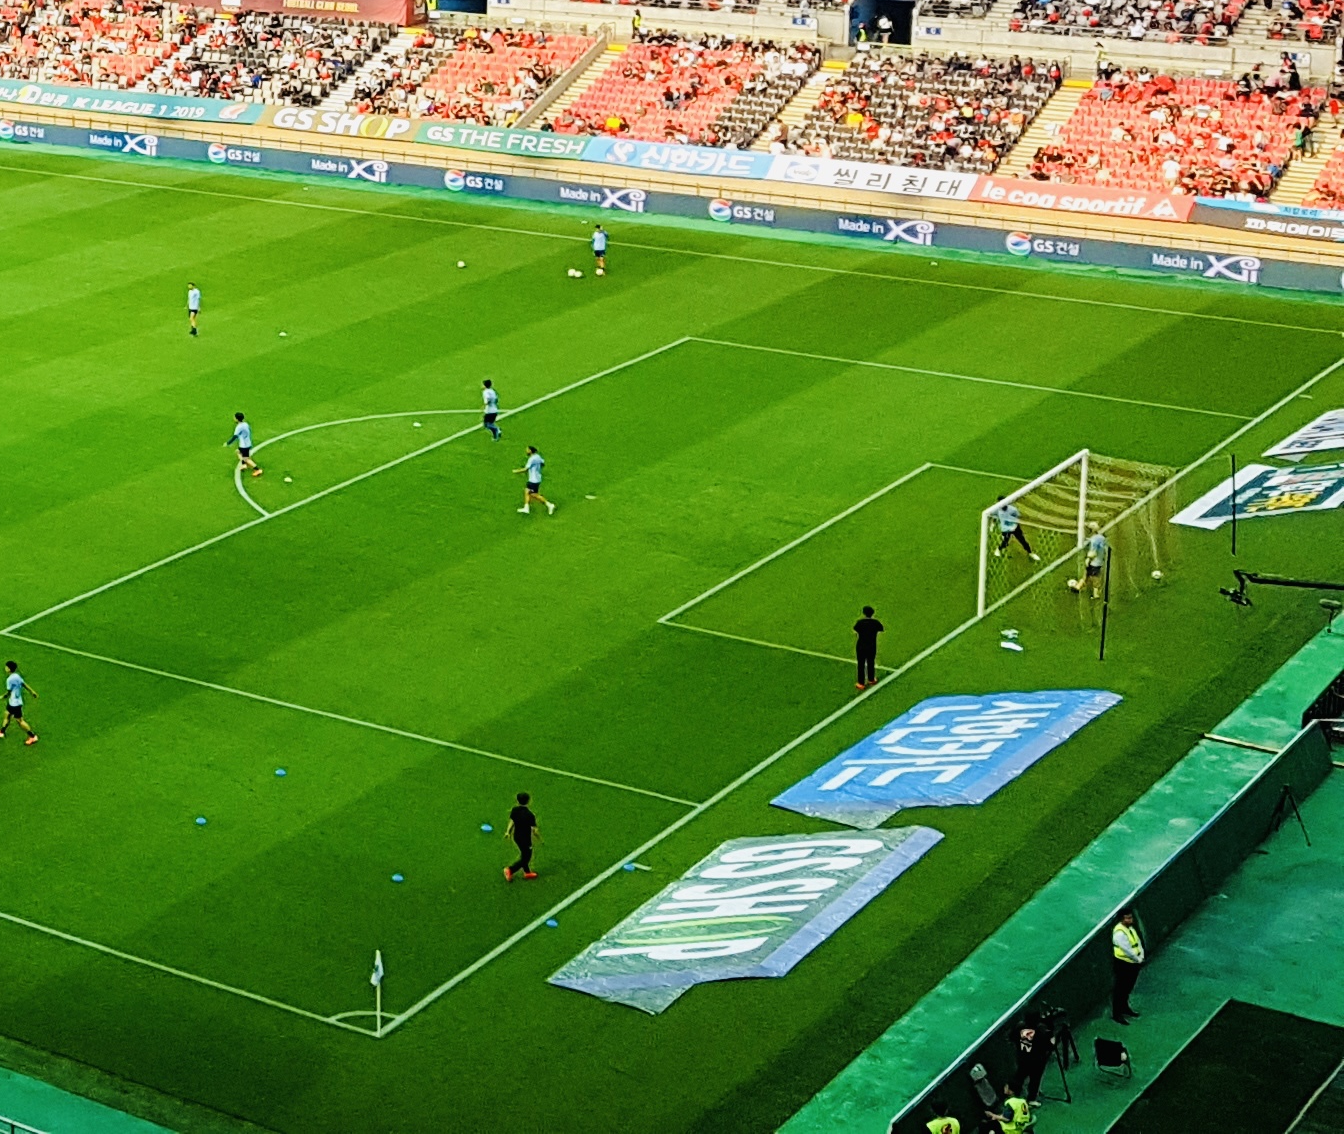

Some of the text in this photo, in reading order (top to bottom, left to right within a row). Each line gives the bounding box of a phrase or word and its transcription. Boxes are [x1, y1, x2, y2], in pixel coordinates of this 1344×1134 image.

[90, 99, 155, 116] LEAGUE
[169, 105, 205, 119] 2019
[273, 108, 410, 139] GS SHOP
[15, 127, 28, 137] GS
[89, 134, 112, 146] Made
[114, 136, 122, 147] in
[427, 126, 585, 155] GS THE FRESH
[227, 149, 242, 161] GS
[641, 145, 755, 175] 신한카드
[312, 159, 338, 171] Made
[339, 161, 348, 173] in
[465, 175, 482, 188] GS
[560, 187, 589, 201] Made
[590, 189, 601, 202] in
[982, 181, 1146, 216] le coq sportif
[733, 205, 752, 218] GS
[838, 218, 870, 232] Made
[872, 222, 884, 234] in
[1033, 239, 1054, 253] GS
[1152, 253, 1188, 268] Made
[1190, 256, 1203, 270] in
